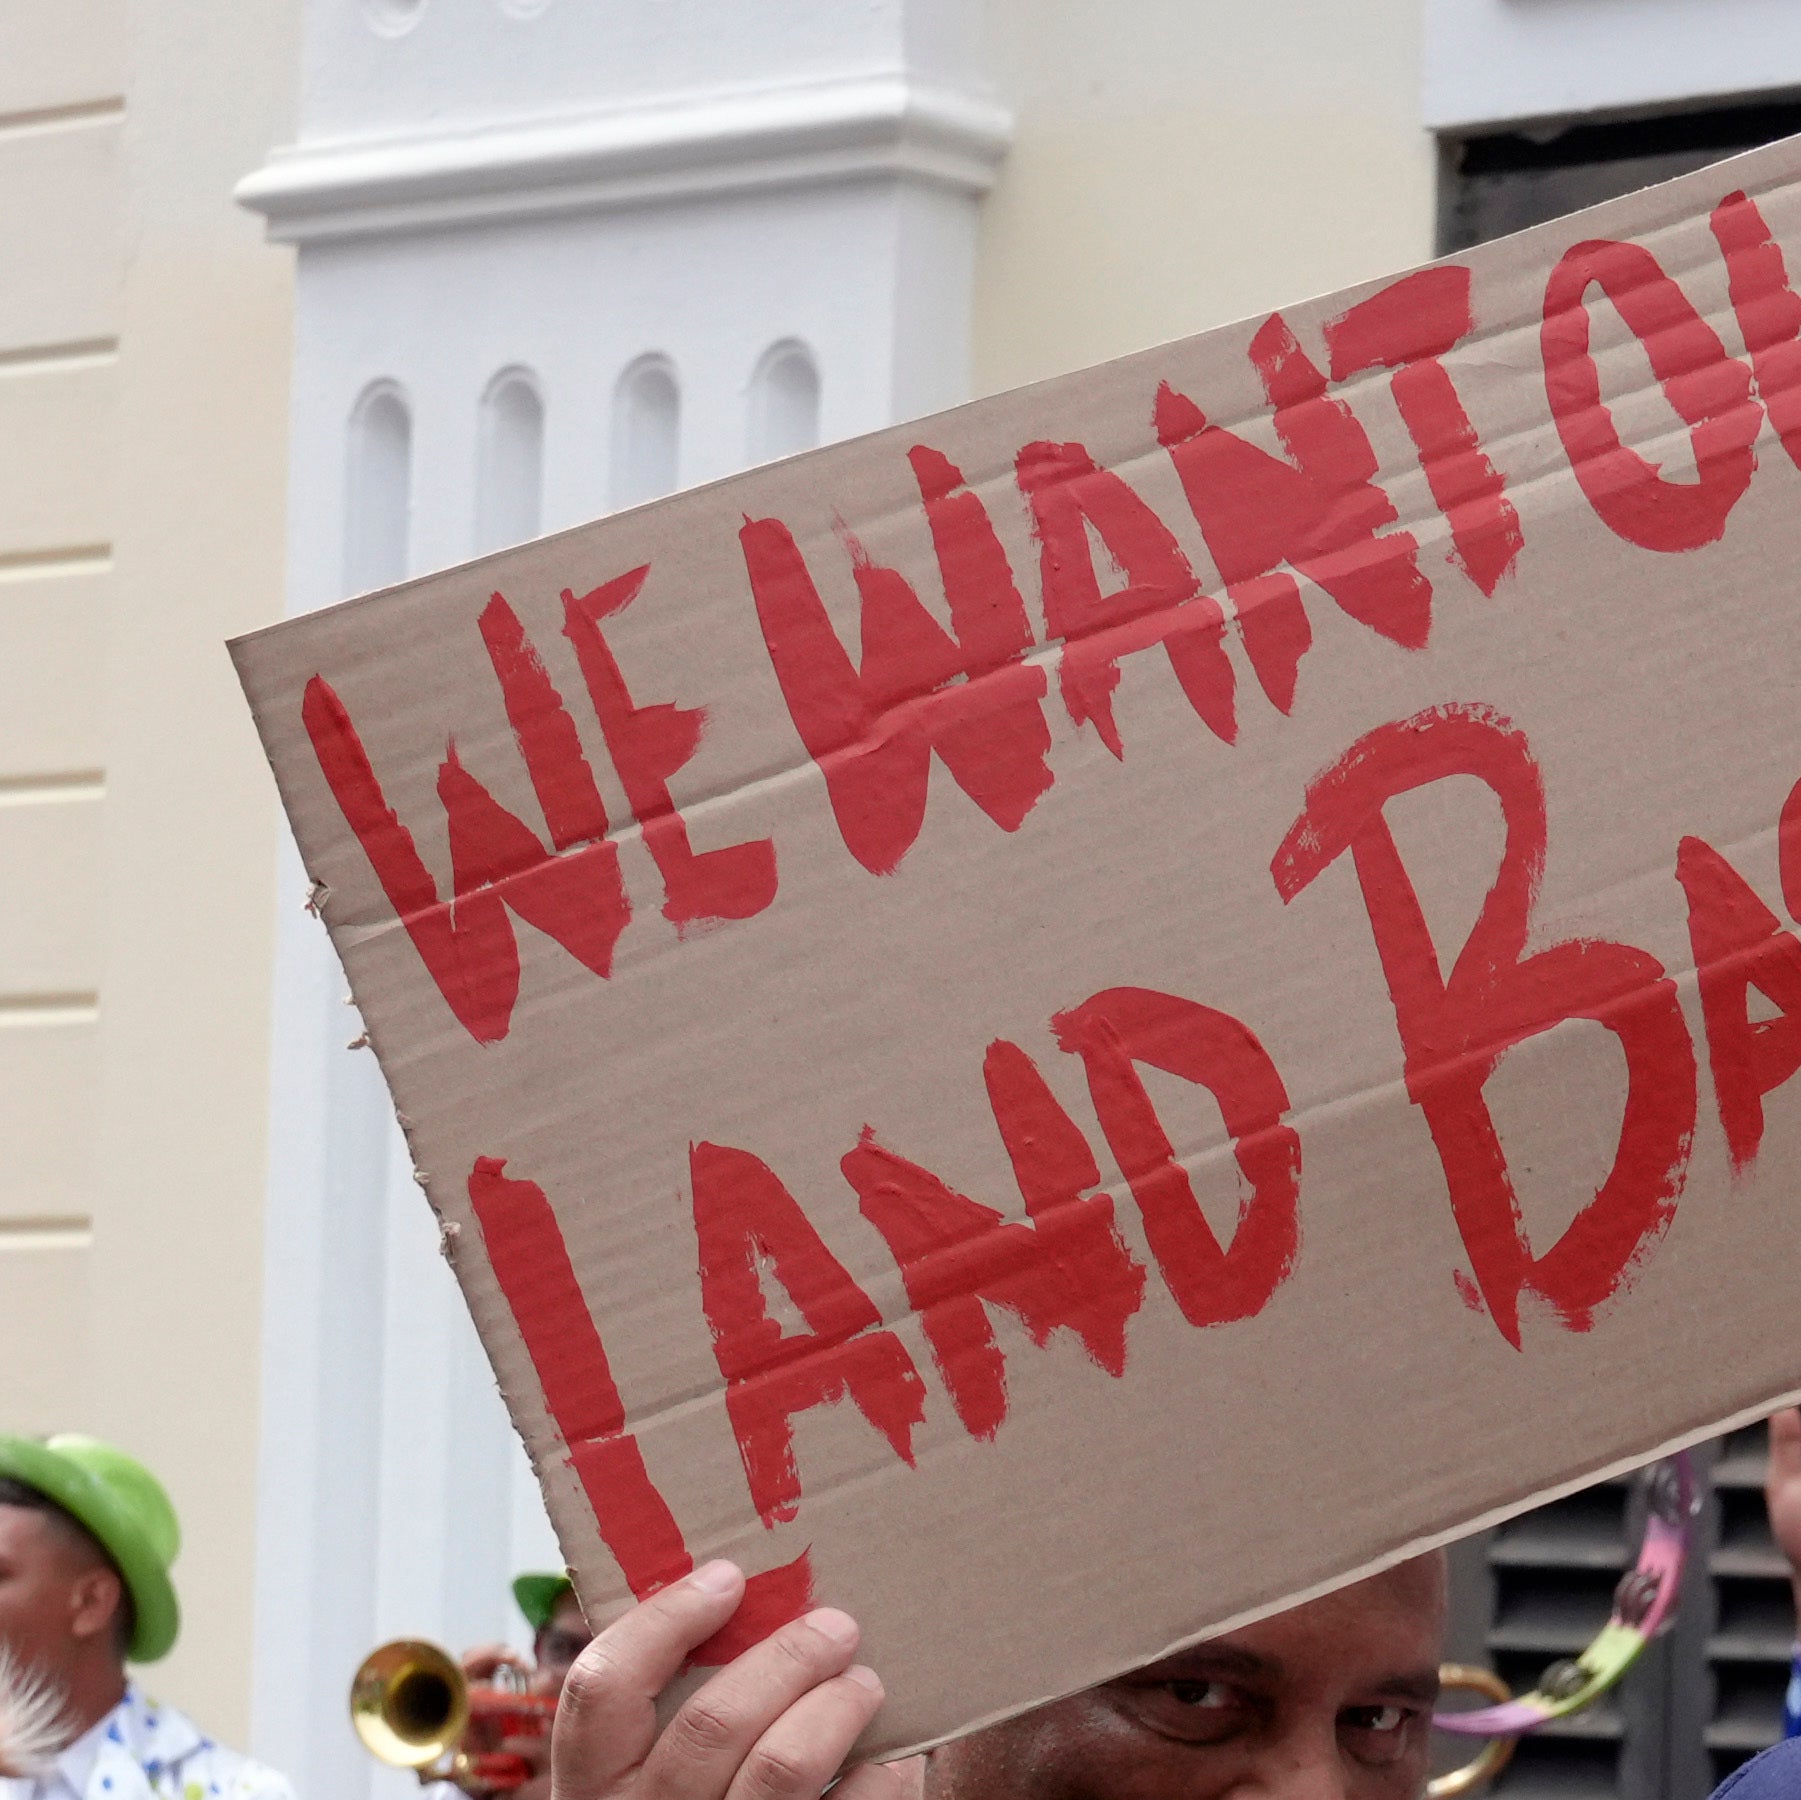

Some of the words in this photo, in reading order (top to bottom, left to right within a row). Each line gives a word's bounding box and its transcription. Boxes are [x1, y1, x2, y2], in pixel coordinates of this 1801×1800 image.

[302, 562, 780, 1046] WE
[737, 264, 1528, 878] WANT
[465, 984, 1305, 1668] LAND
